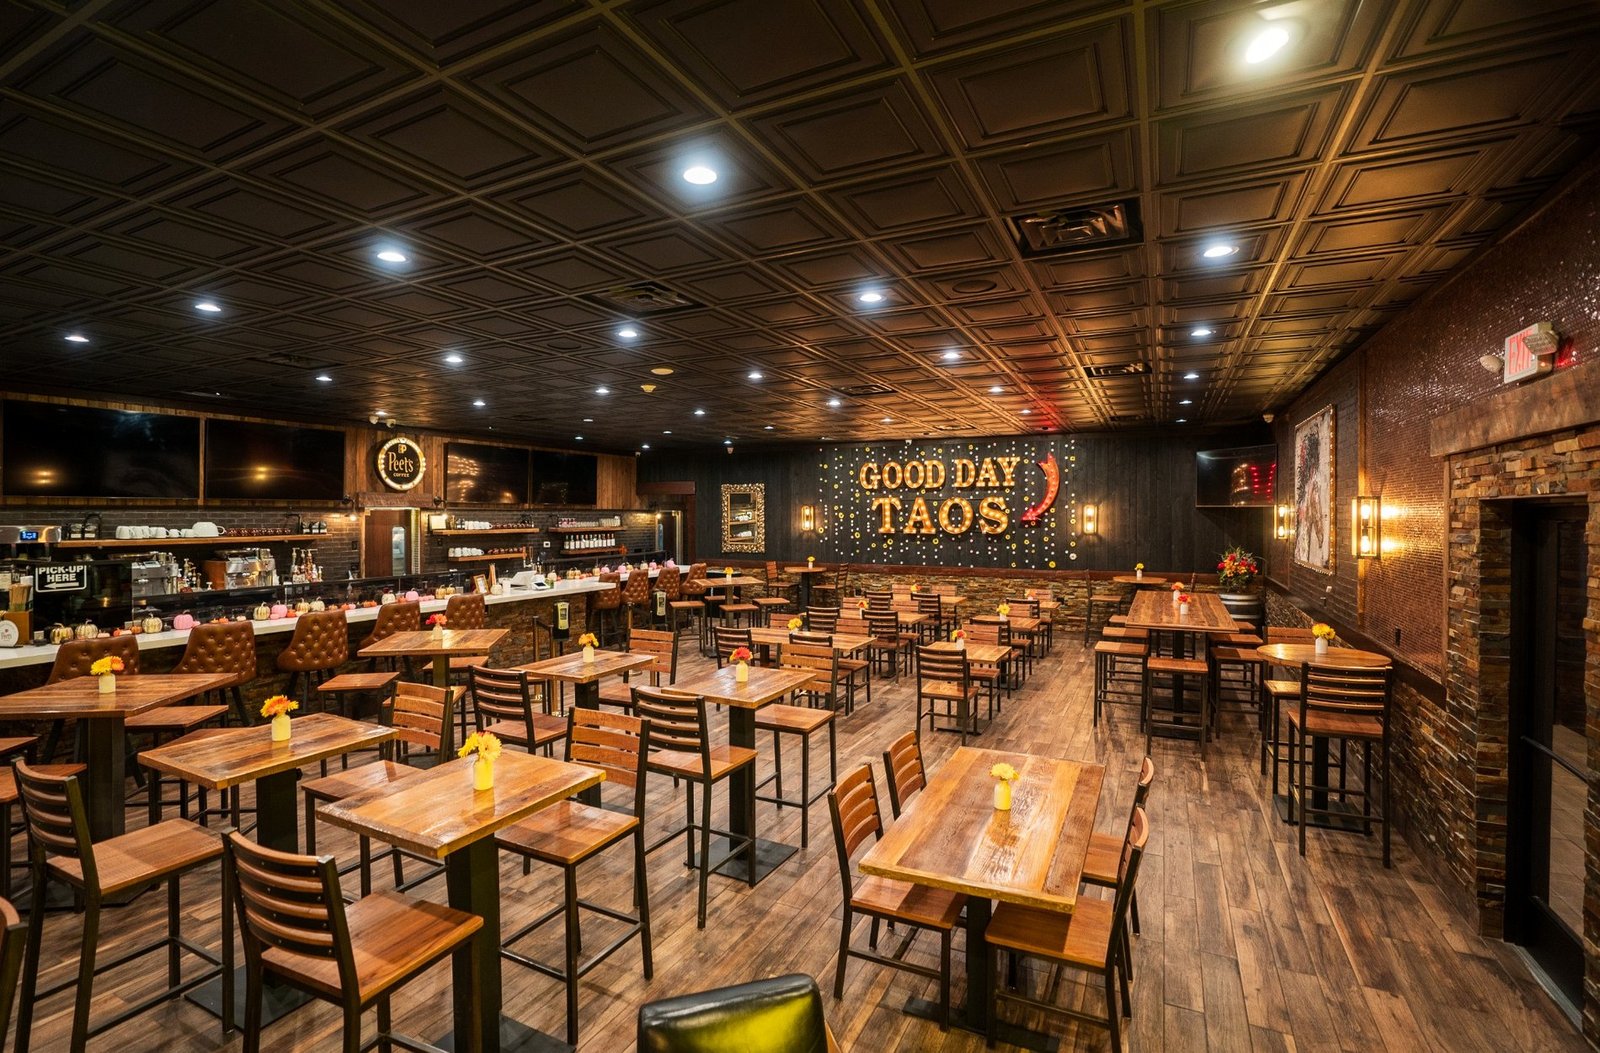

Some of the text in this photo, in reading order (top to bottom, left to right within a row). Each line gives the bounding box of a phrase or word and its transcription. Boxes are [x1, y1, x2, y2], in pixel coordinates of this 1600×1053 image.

[859, 456, 1021, 489] GOOD DAY
[871, 496, 1009, 535] TAOS
[38, 565, 84, 575] PICK-UP
[46, 573, 77, 583] HERE
